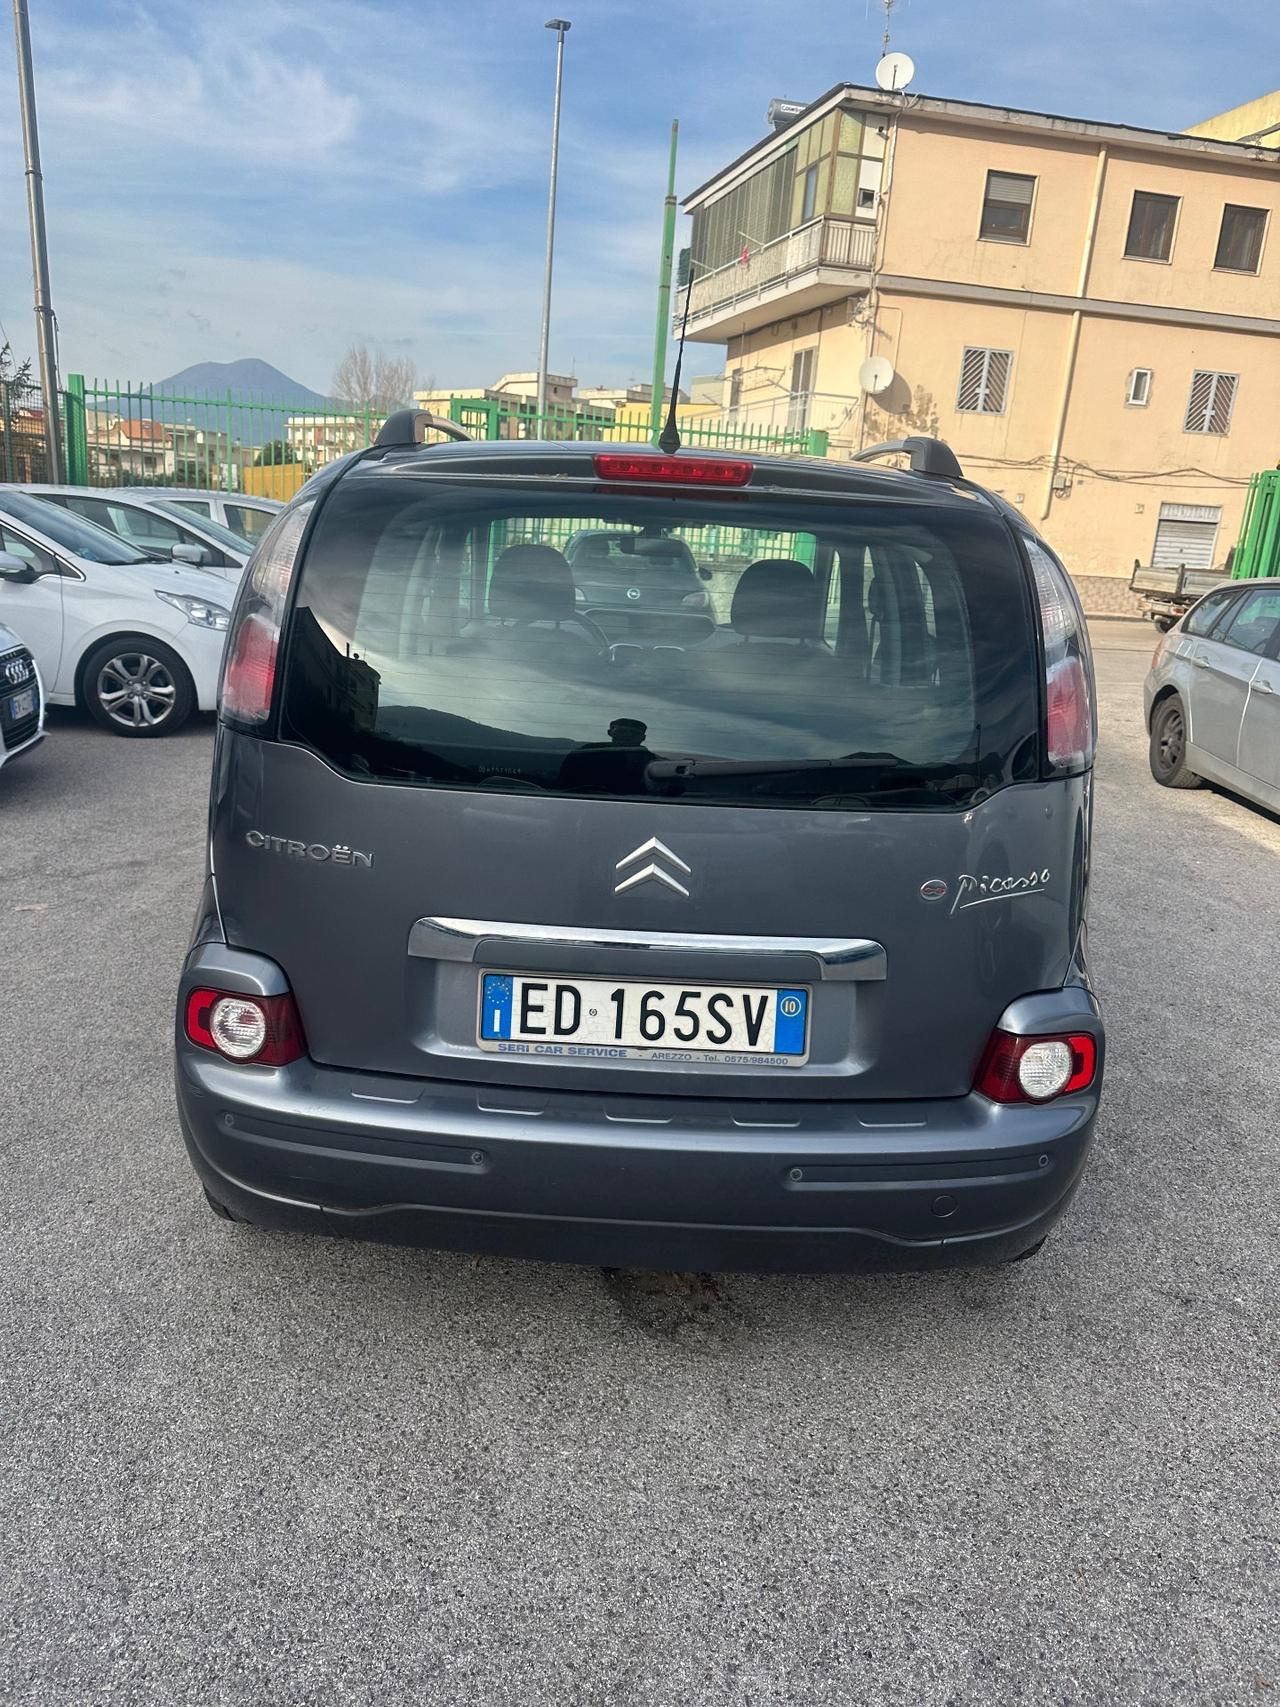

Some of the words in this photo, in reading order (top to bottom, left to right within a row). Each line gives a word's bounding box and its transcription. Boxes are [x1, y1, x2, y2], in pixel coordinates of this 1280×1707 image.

[246, 830, 374, 867] CITROËN
[950, 868, 1050, 915] Picasso
[519, 982, 581, 1036] ED
[610, 988, 769, 1046] 165SV
[498, 1043, 530, 1053] SERI
[534, 1045, 563, 1054] CAR
[567, 1046, 628, 1058] SERVICE
[652, 1052, 692, 1061] AREZZO
[703, 1054, 720, 1062] Tel.
[724, 1055, 789, 1065] 0575/984500
